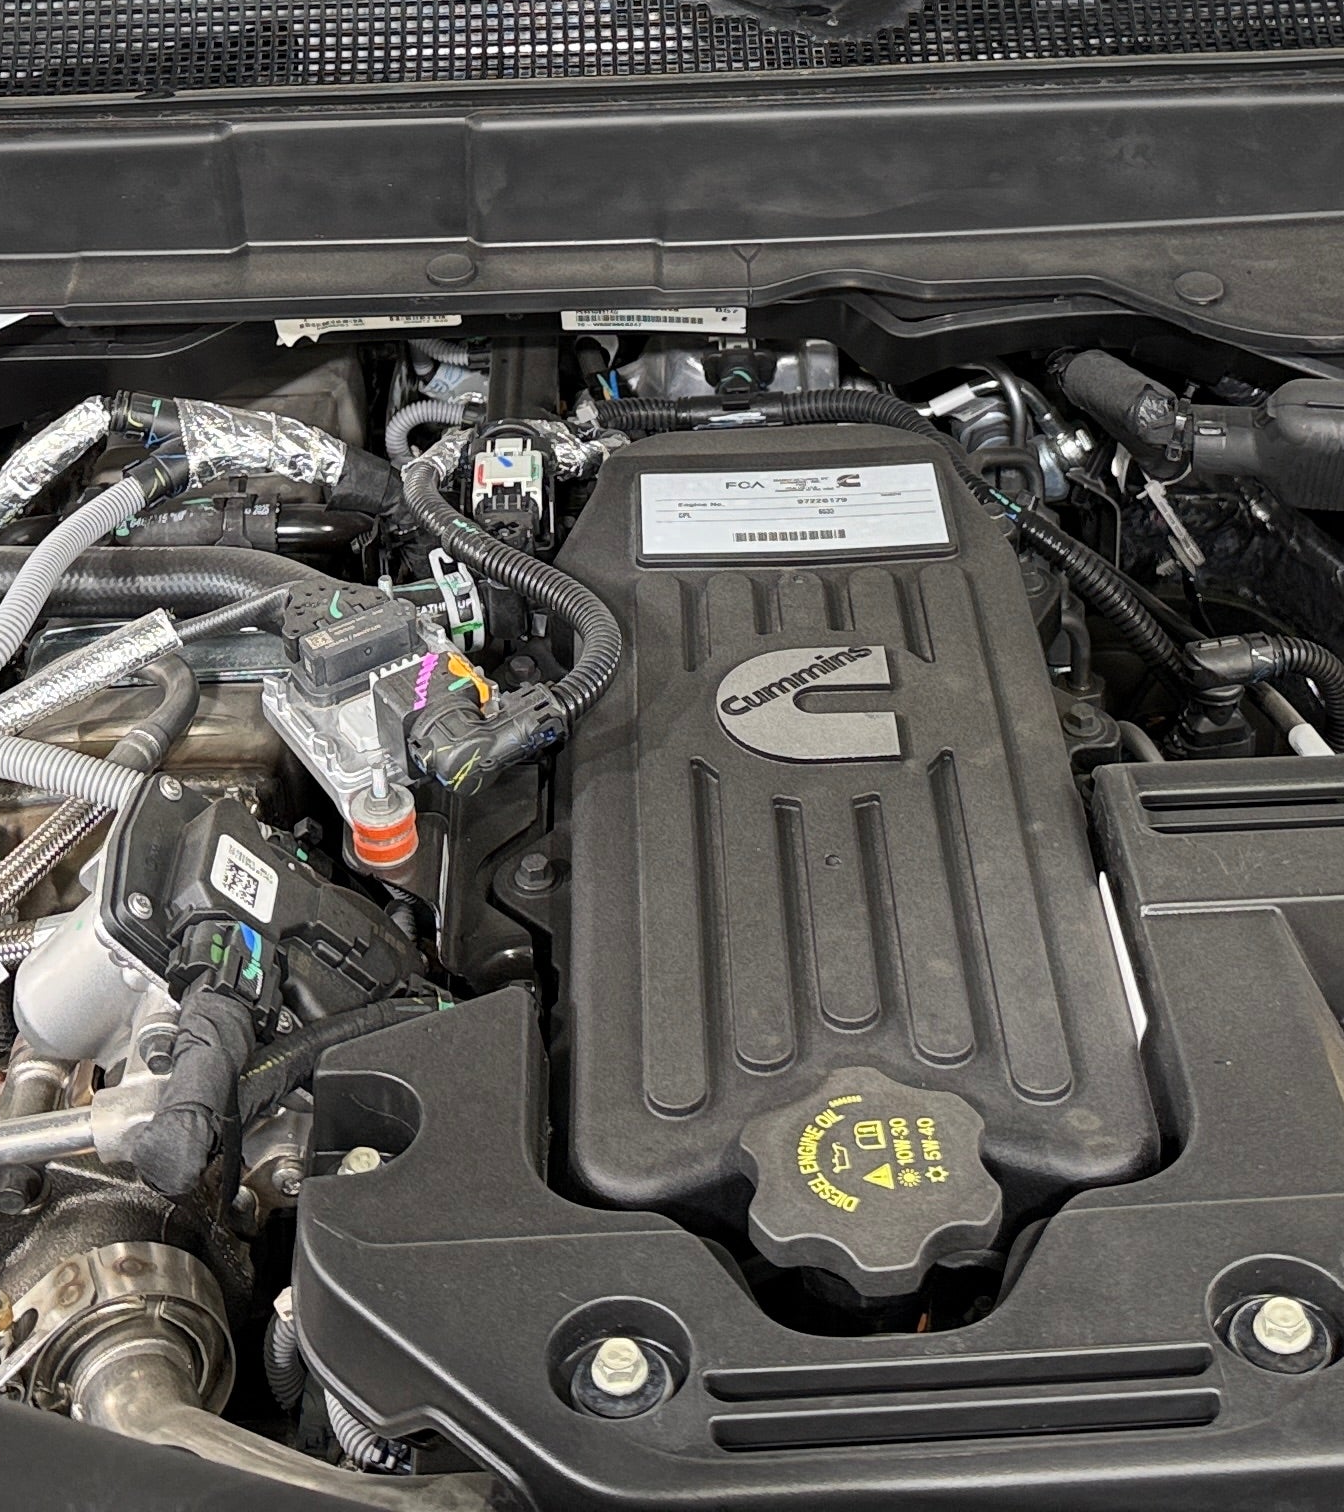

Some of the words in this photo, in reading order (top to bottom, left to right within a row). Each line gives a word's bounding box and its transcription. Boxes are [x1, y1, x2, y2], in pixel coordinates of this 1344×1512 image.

[725, 481, 765, 489] FCA
[720, 646, 873, 716] Cummins
[814, 1108, 846, 1129] OIL
[916, 1117, 942, 1161] 5W-40
[797, 1124, 826, 1175] ENGINE
[888, 1117, 915, 1166] 10W-30
[808, 1172, 861, 1212] DIESEL
